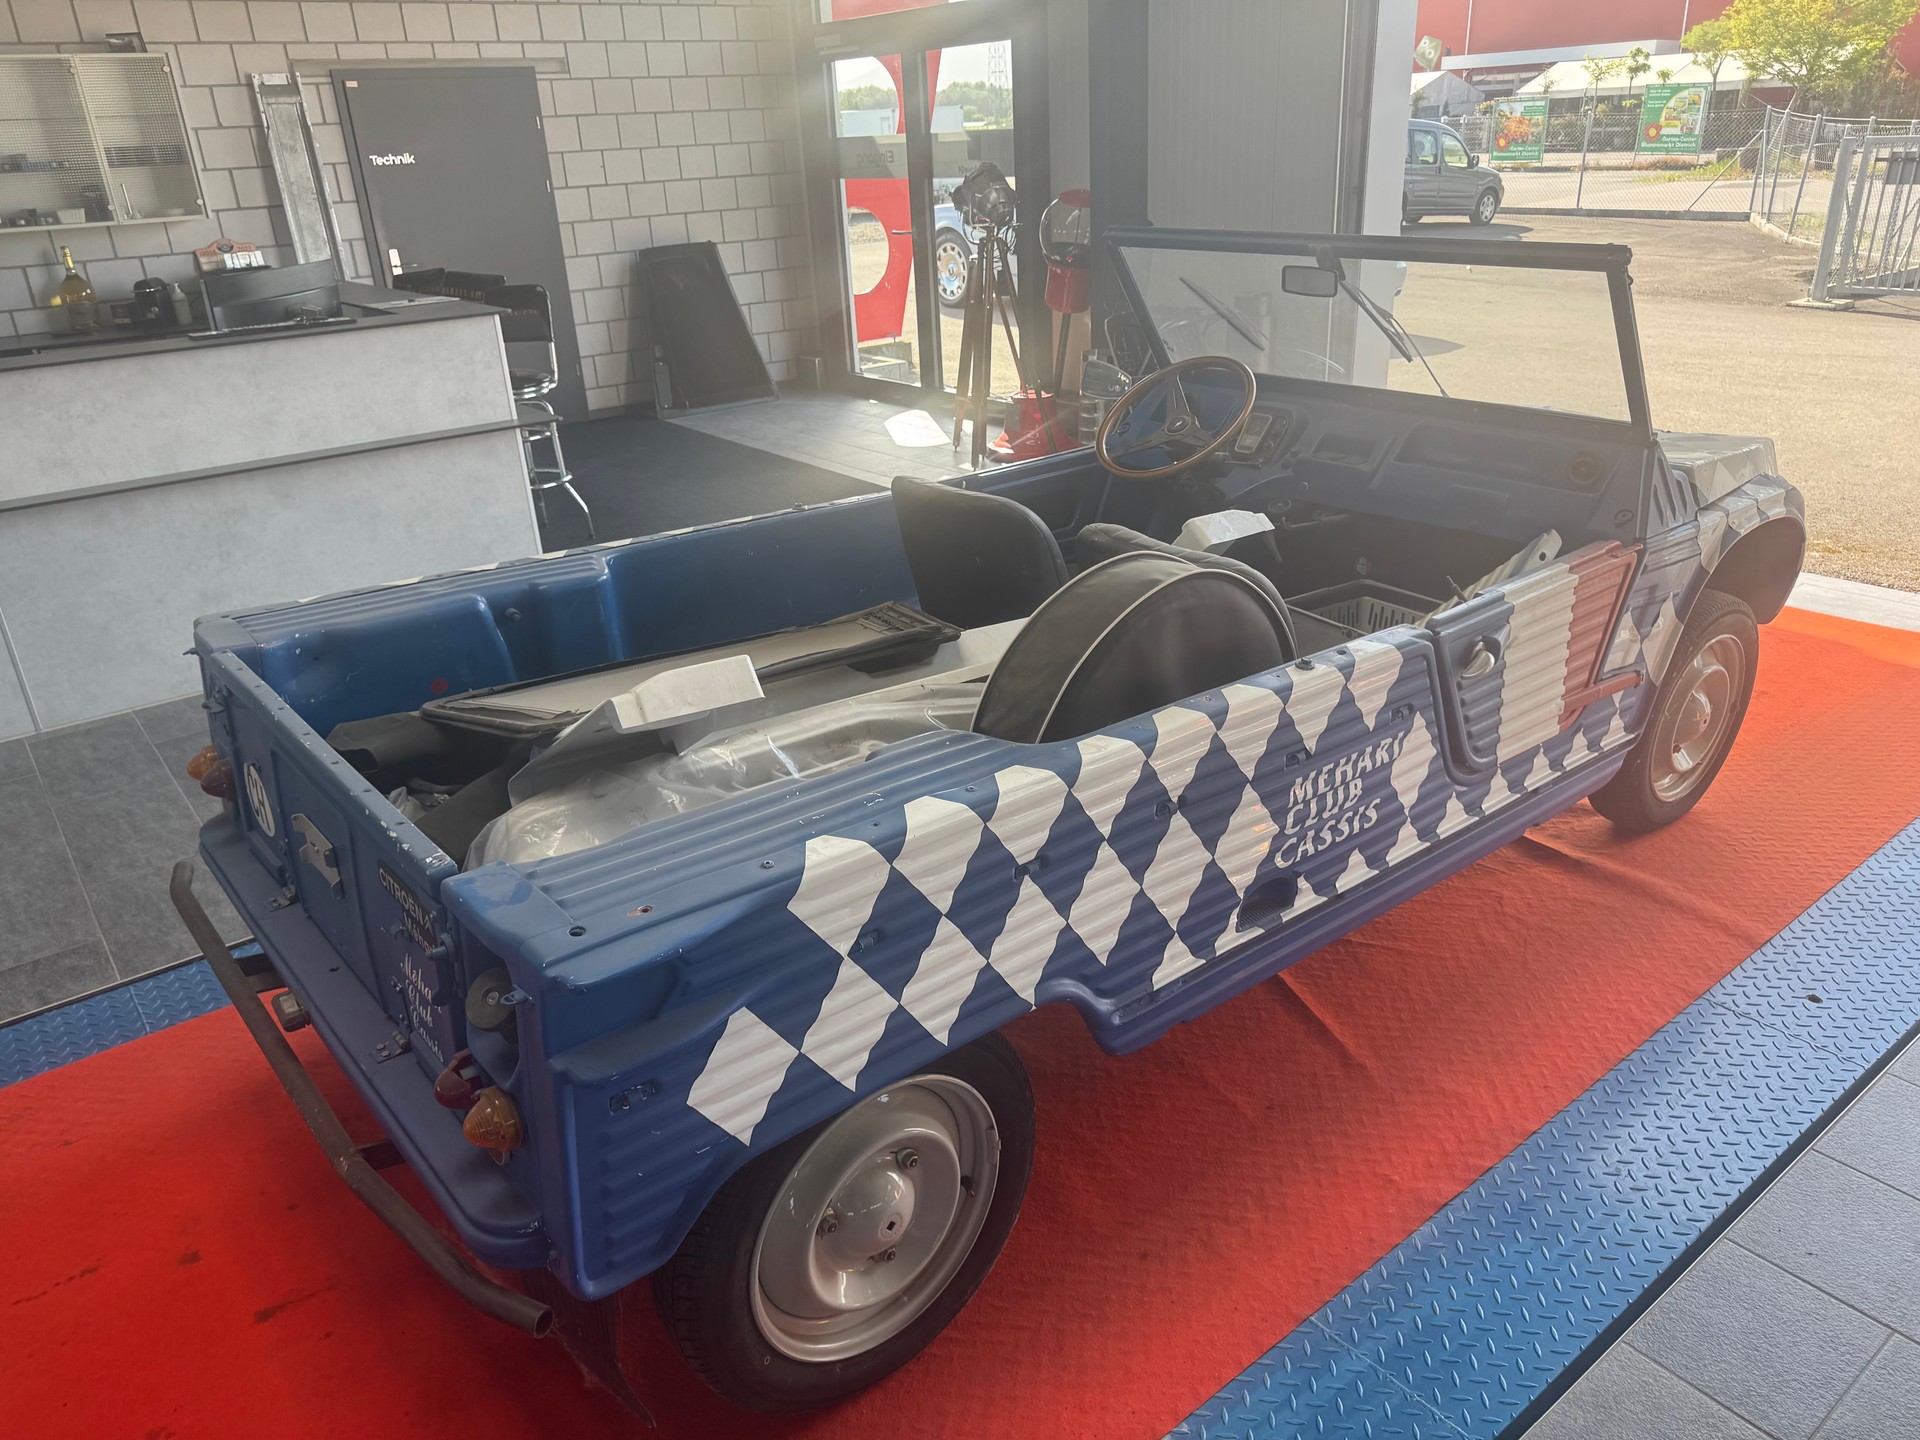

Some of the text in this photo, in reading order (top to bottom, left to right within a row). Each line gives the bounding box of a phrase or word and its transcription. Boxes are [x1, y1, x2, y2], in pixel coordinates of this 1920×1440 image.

[368, 152, 416, 166] Technik
[1287, 731, 1405, 809] MEHARI
[247, 772, 272, 832] CH
[1283, 778, 1364, 835] CLUB
[1273, 798, 1382, 869] CASSIS
[379, 867, 423, 925] CITROËN
[405, 979, 434, 1028] Club
[410, 1006, 444, 1063] Cassis
